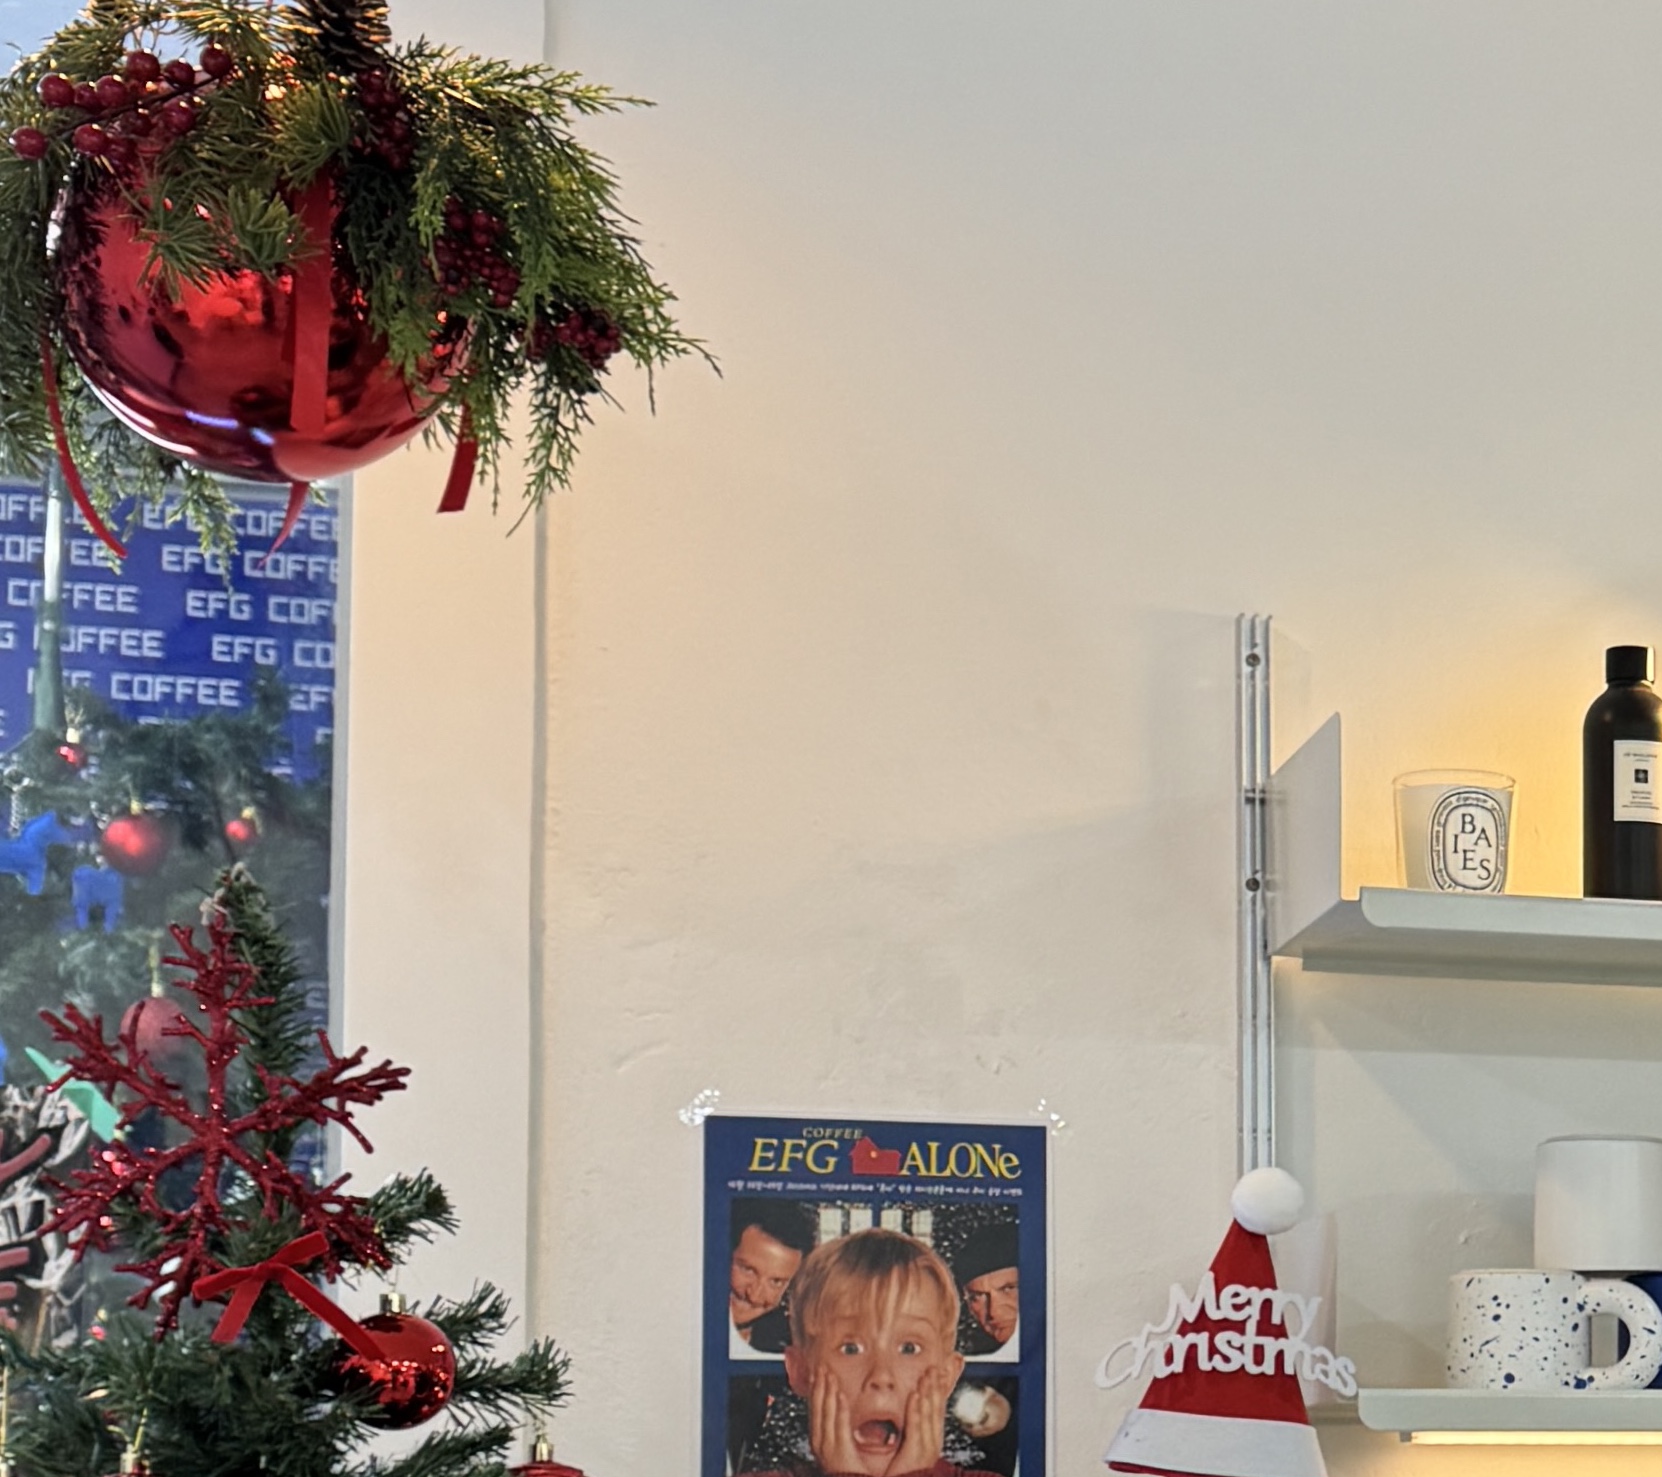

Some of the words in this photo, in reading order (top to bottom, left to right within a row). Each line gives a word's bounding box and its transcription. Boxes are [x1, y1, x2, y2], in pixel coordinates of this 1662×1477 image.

[186, 590, 251, 620] EFG
[211, 633, 277, 665] EFG
[110, 672, 241, 707] COFFEE
[802, 1126, 862, 1140] COFFEE
[748, 1137, 839, 1175] EFG
[1147, 1270, 1323, 1339] Merry
[1094, 1318, 1359, 1398] Christmas
